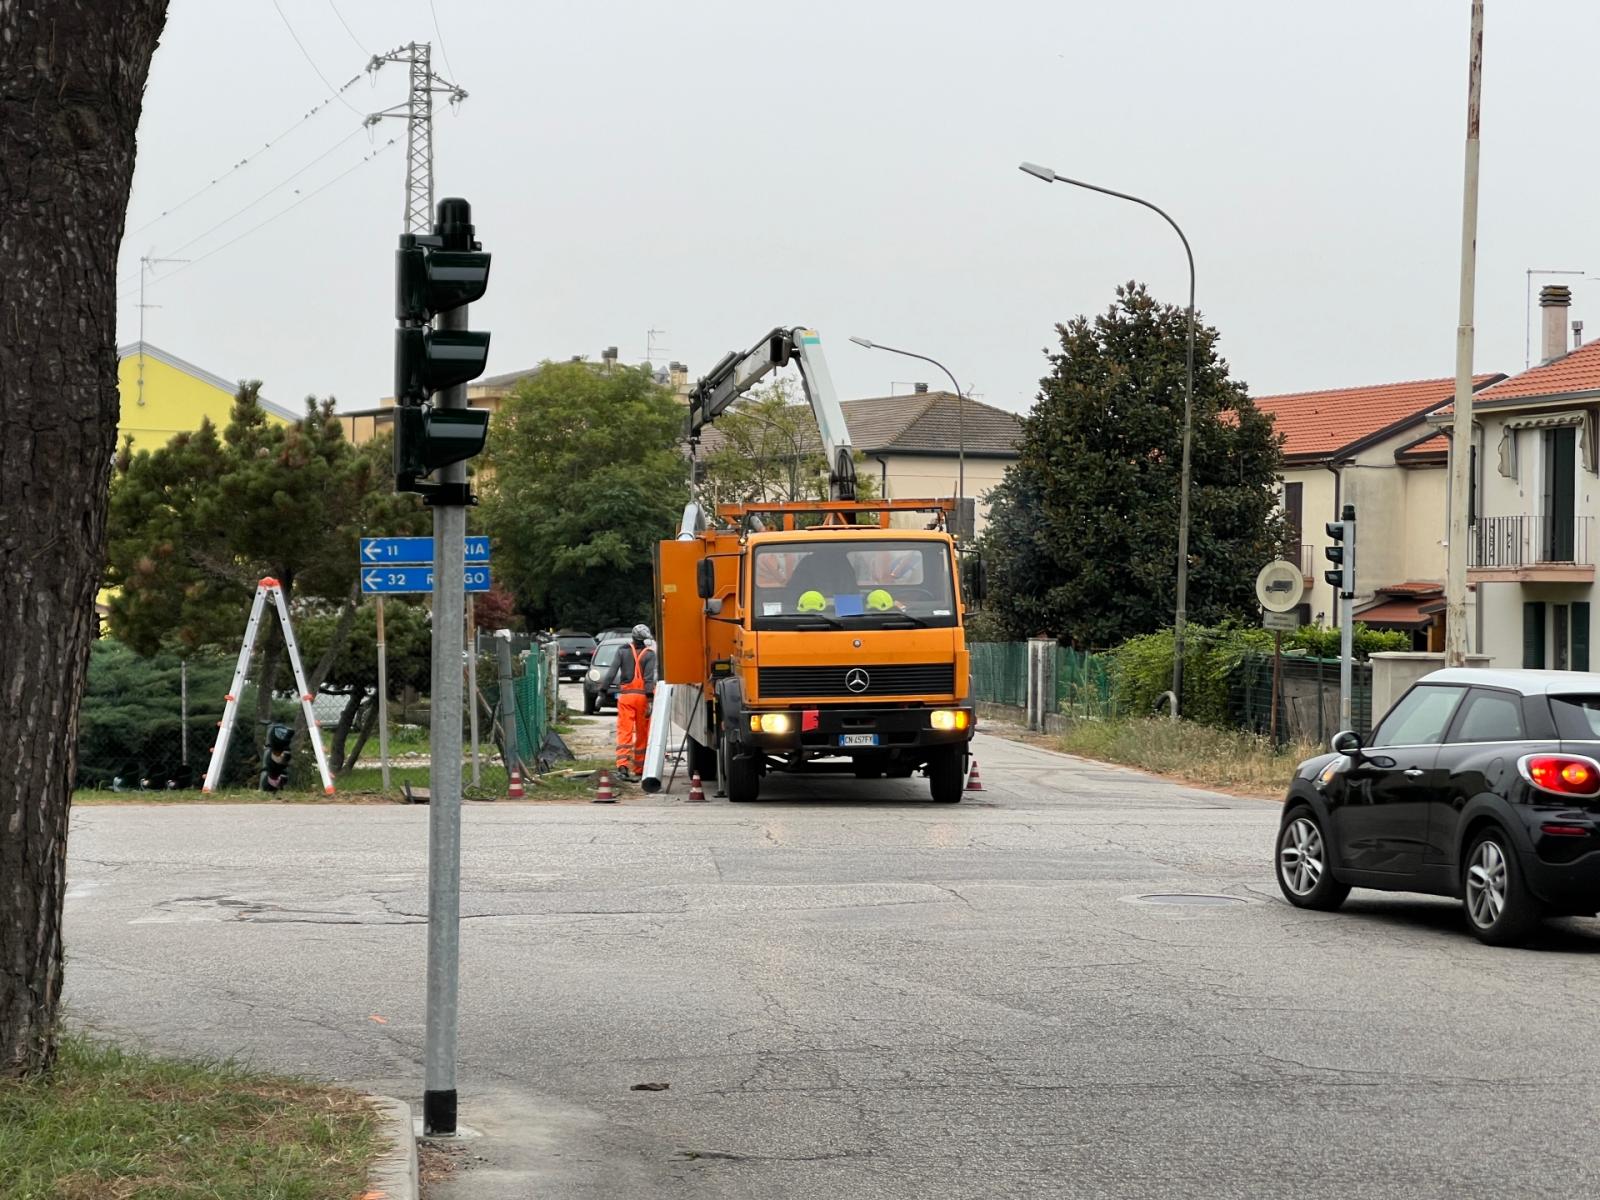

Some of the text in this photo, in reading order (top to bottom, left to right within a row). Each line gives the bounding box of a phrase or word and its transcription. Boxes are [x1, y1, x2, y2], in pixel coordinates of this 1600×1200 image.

[386, 545, 398, 556] 11
[388, 572, 485, 585] 32 RGO
